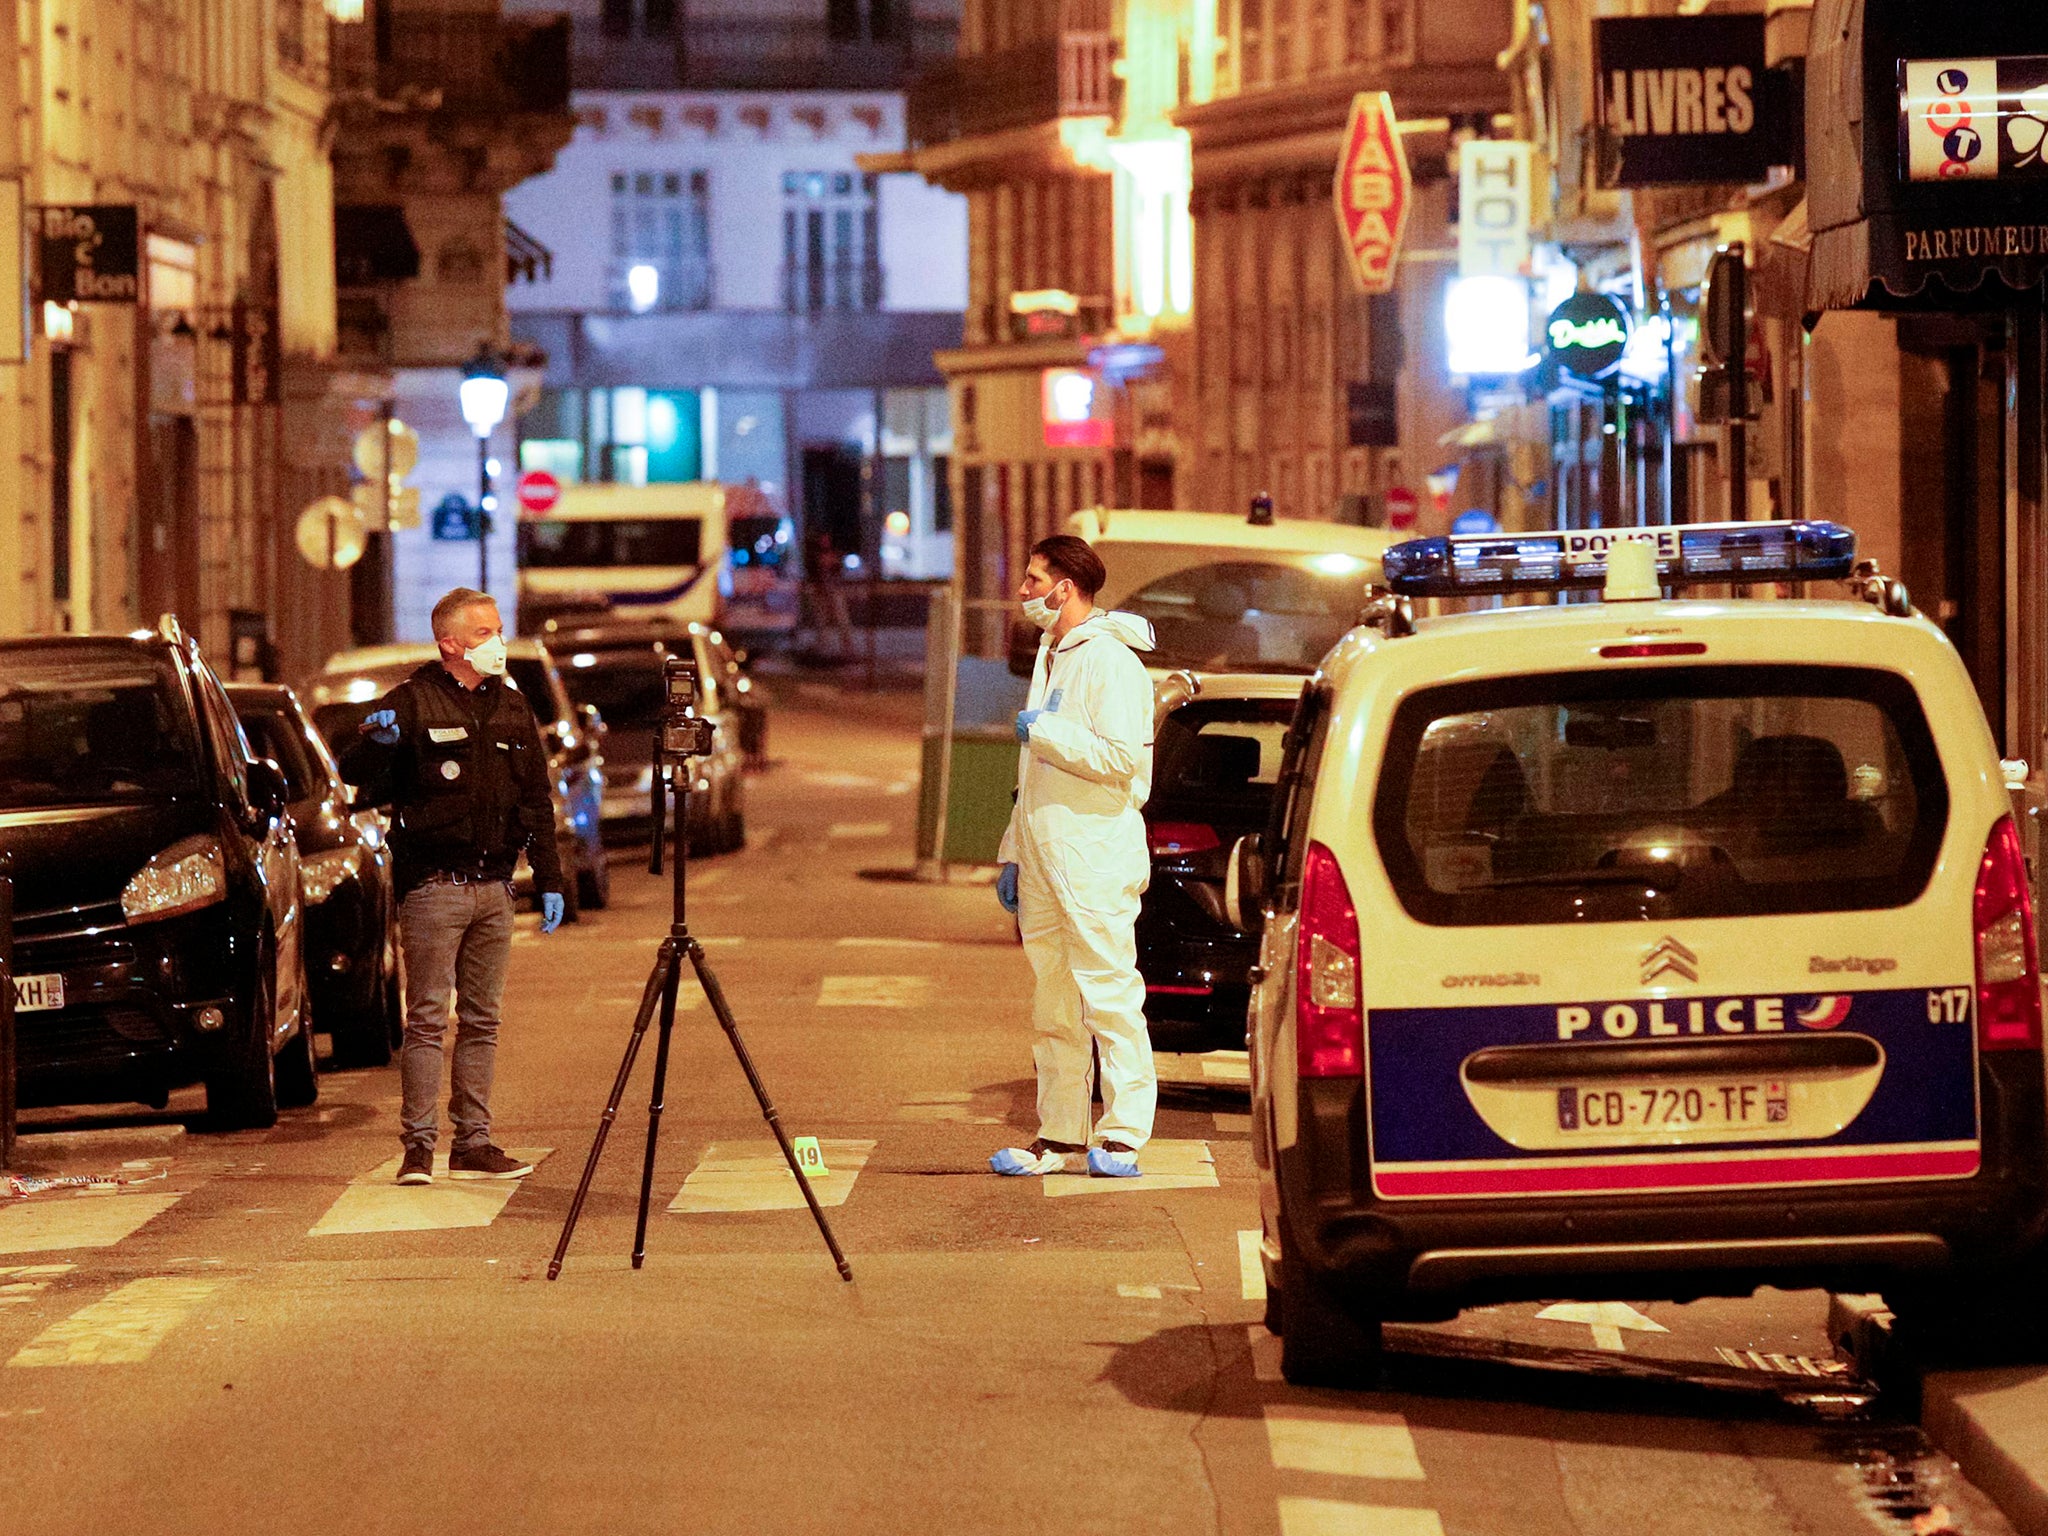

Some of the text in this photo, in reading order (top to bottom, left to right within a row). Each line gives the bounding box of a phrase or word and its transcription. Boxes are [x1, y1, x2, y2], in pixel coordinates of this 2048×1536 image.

[1607, 65, 1754, 134] LIVRES
[1352, 103, 1394, 279] TABAC
[1557, 999, 1785, 1040] POLICE
[797, 1147, 819, 1167] 19
